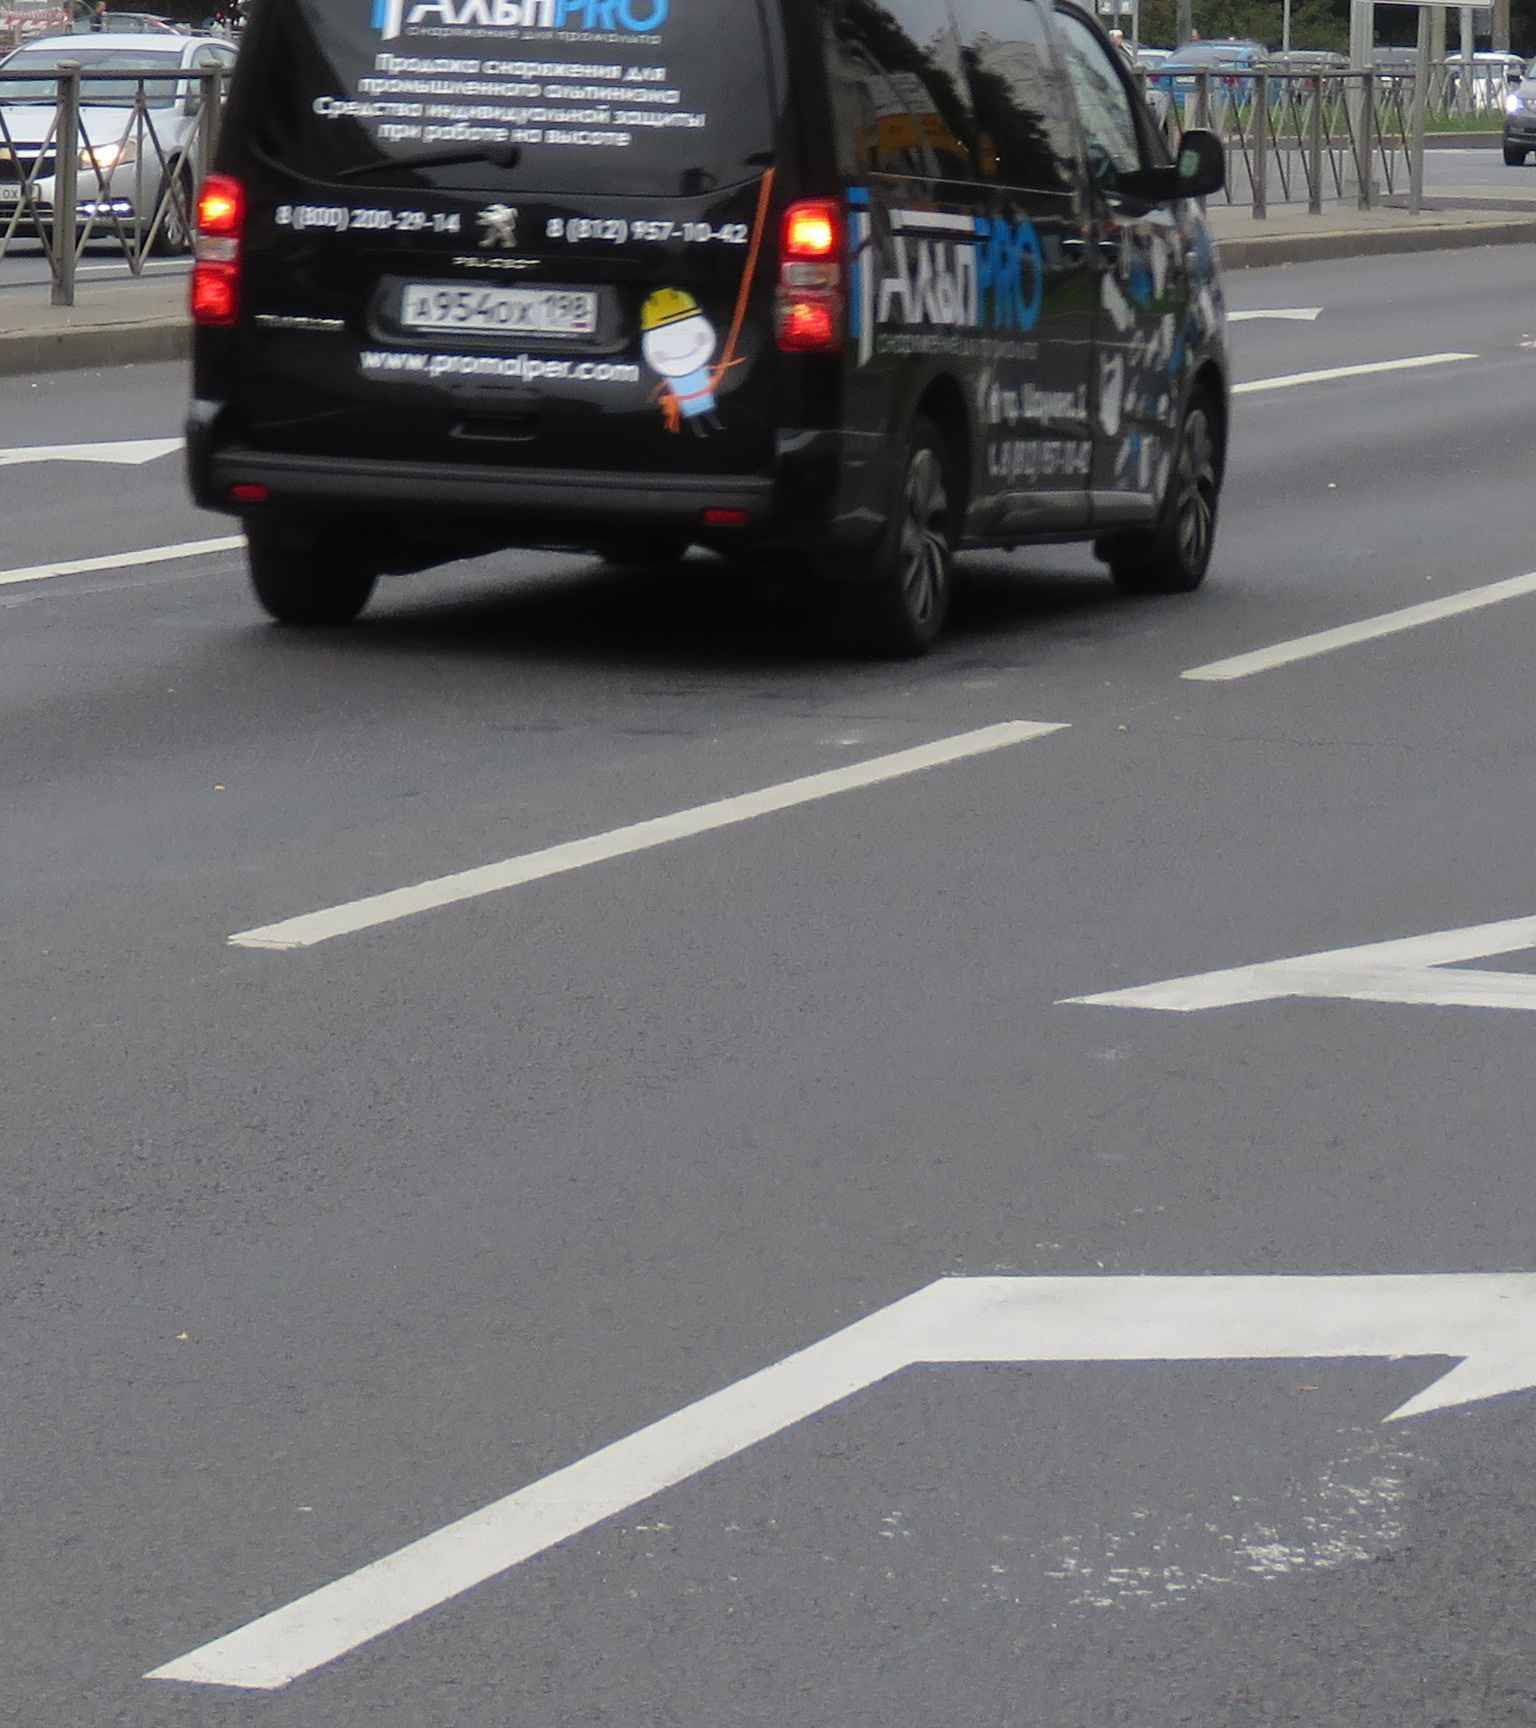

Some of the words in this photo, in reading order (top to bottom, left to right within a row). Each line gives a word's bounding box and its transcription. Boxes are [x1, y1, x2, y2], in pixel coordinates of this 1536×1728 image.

[375, 53, 480, 75] Продажа
[622, 67, 666, 83] для
[274, 205, 293, 225] 8
[545, 218, 563, 238] 8
